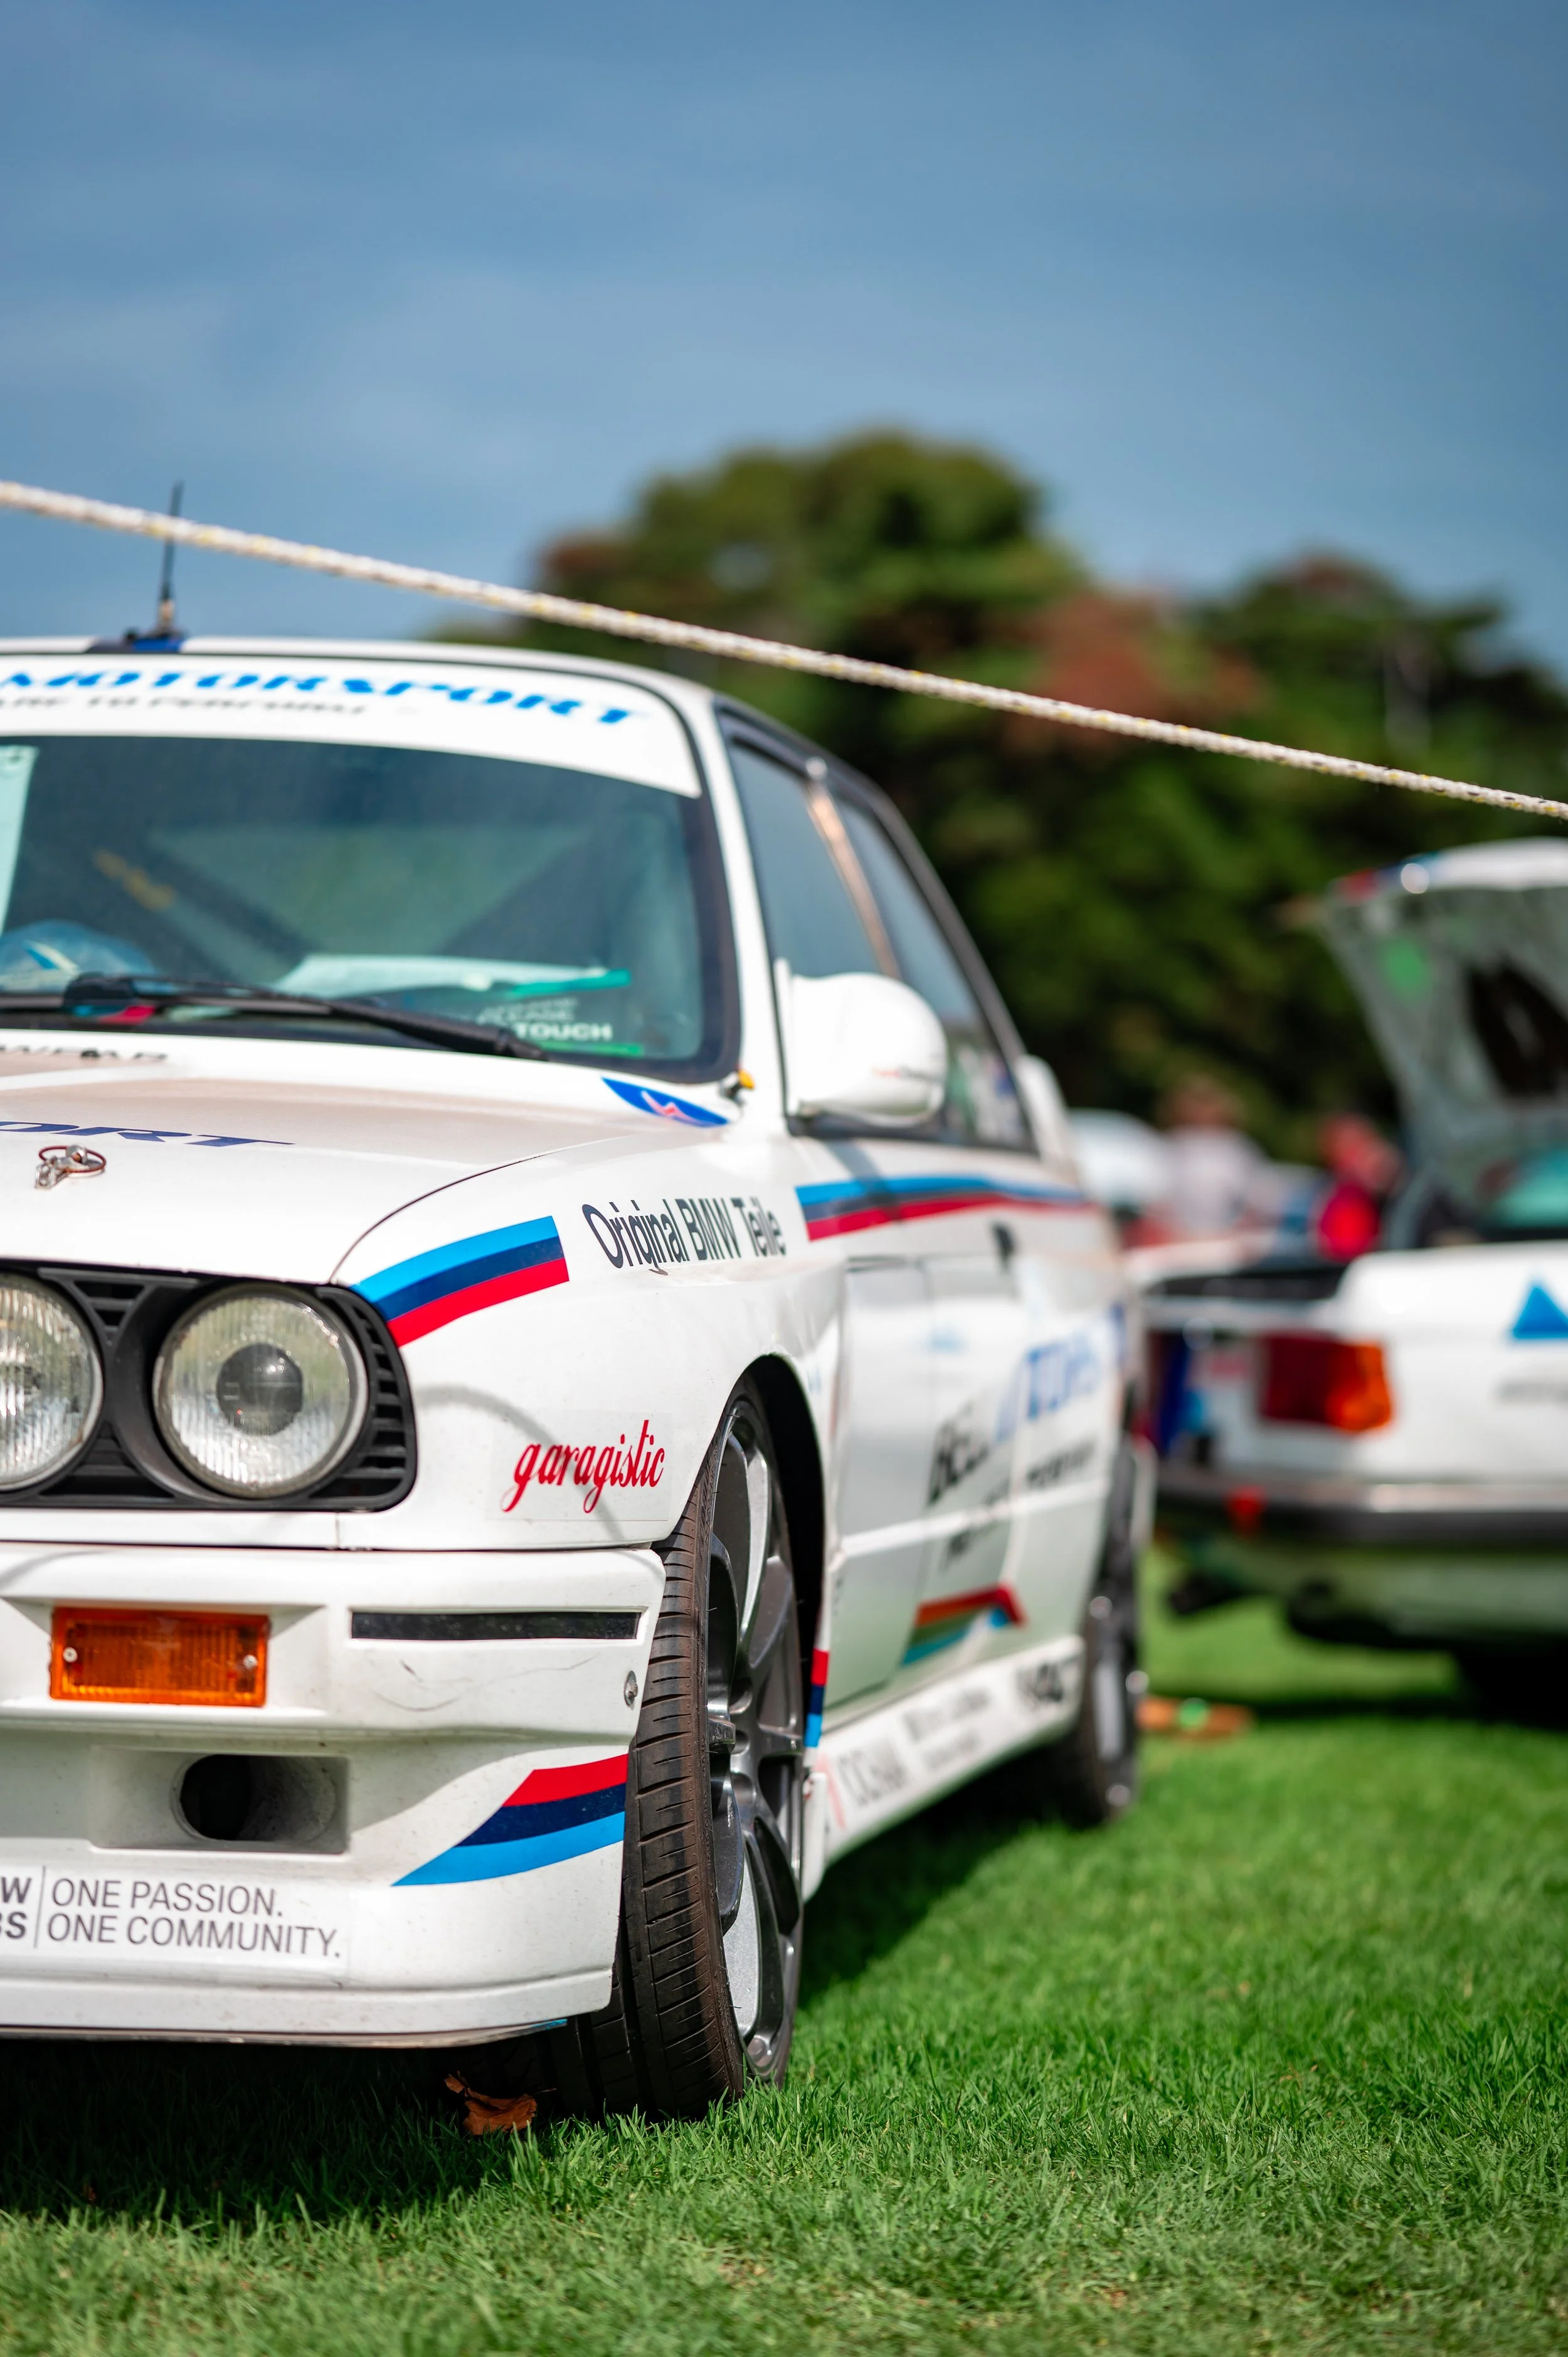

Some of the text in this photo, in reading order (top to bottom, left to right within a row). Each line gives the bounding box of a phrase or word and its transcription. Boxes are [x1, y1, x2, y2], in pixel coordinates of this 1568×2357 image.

[514, 1022, 613, 1041] TOUCH
[0, 1121, 295, 1147] ORT
[582, 1196, 787, 1275] Original BMW Teile
[501, 1419, 665, 1513] garagistic
[52, 1878, 283, 1917] ONE PASSION.
[47, 1912, 341, 1958] ONE COMMUNITY.
